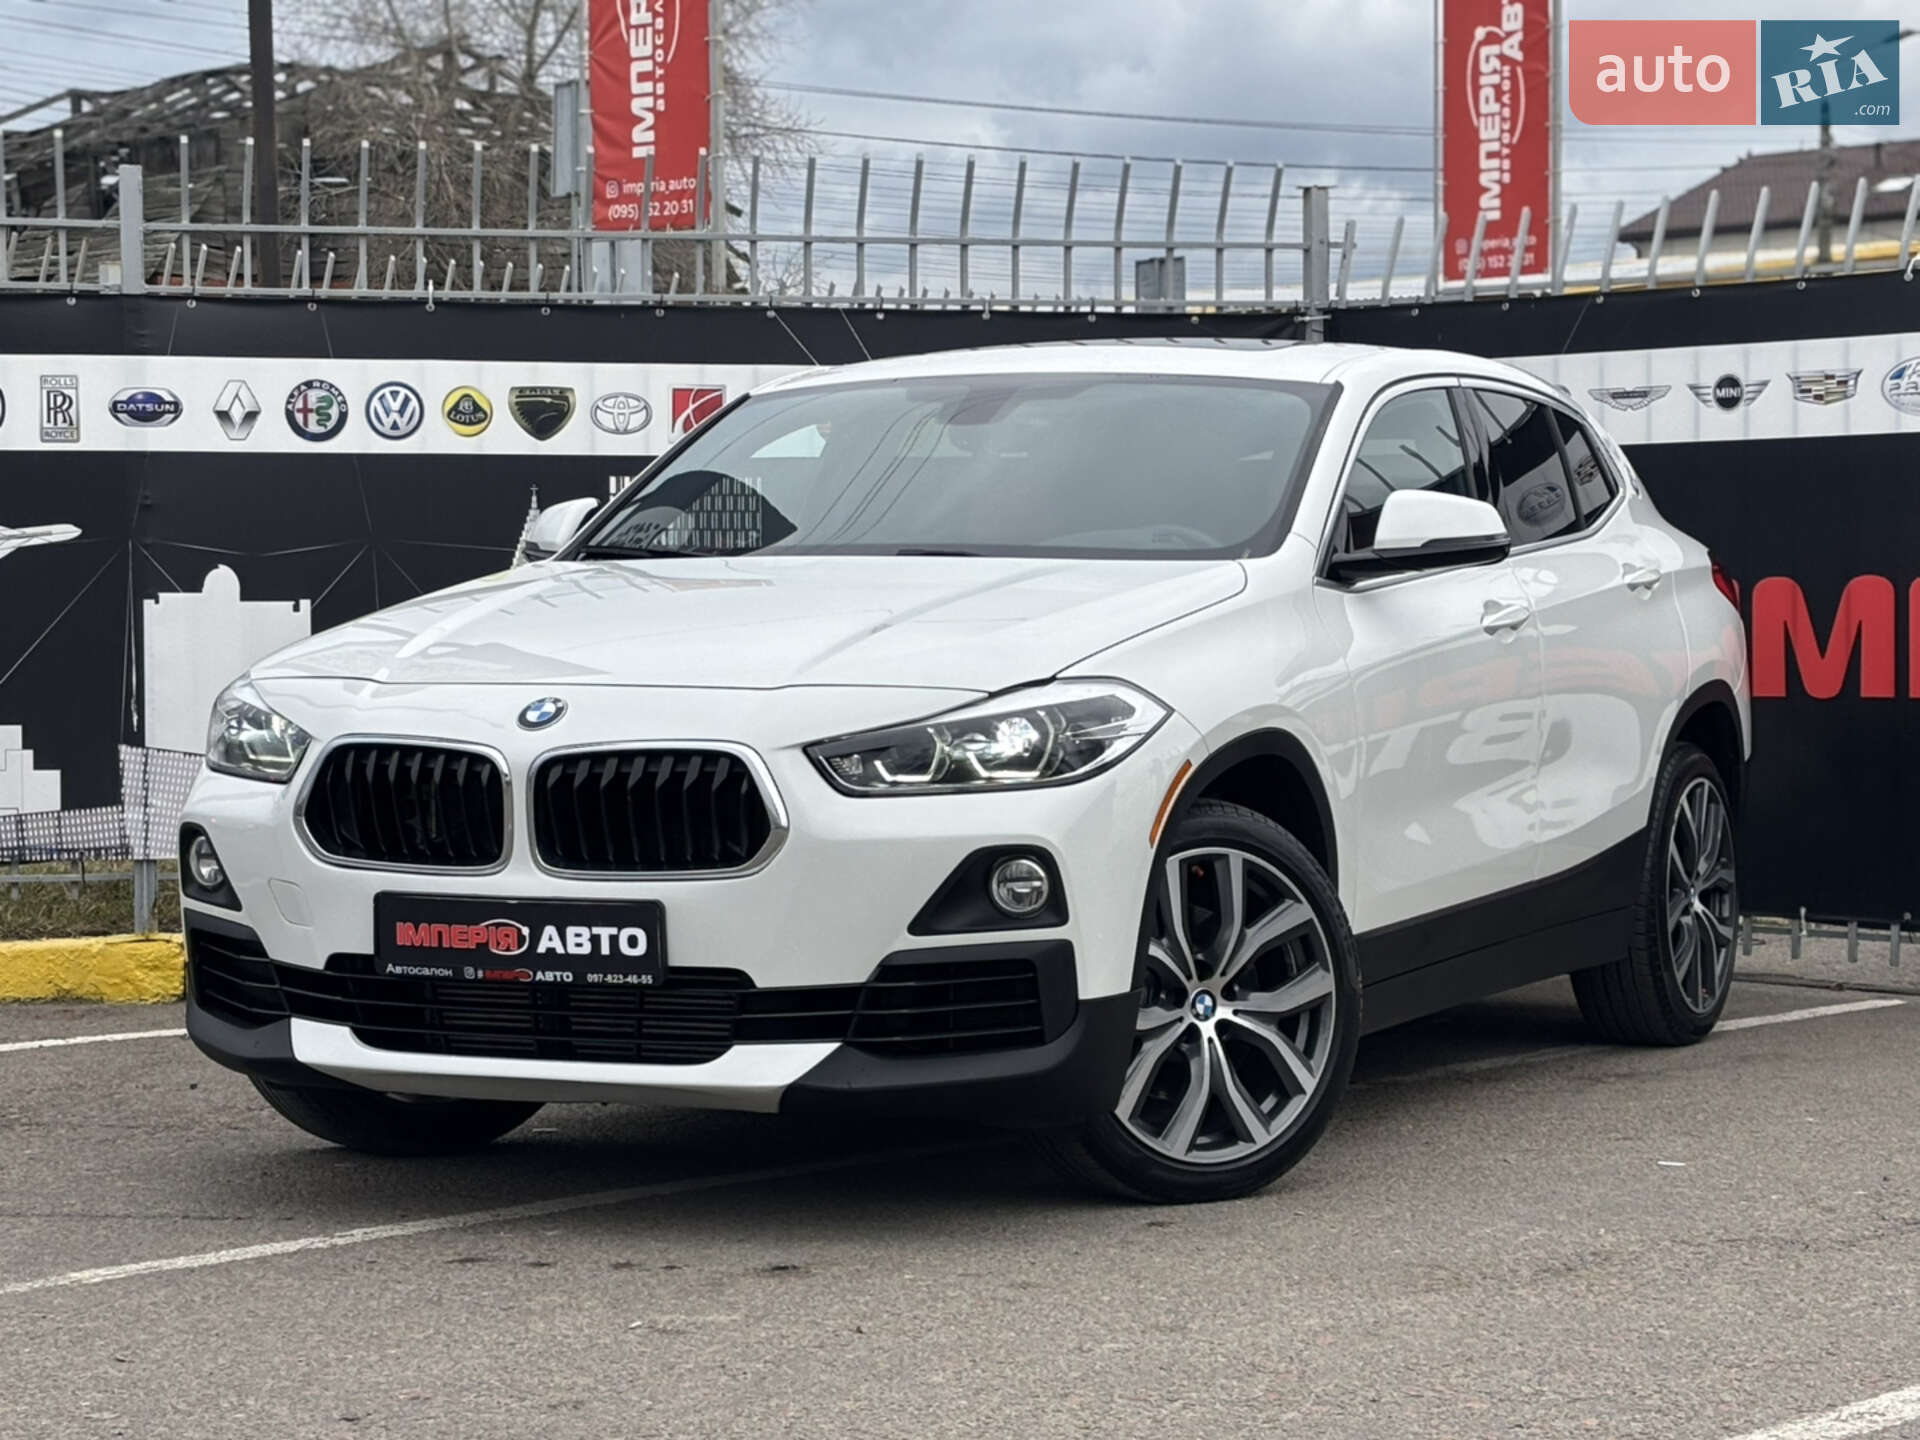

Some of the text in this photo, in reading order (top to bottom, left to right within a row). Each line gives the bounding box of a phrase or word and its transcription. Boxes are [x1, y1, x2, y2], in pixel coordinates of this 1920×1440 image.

[622, 177, 696, 196] impria_auto
[608, 203, 639, 221] (095)
[664, 201, 679, 215] 20
[681, 199, 694, 213] 31
[1716, 387, 1741, 398] MINI
[116, 402, 175, 412] DATSUN
[396, 922, 648, 957] ІМПЕРІЯ АВТО
